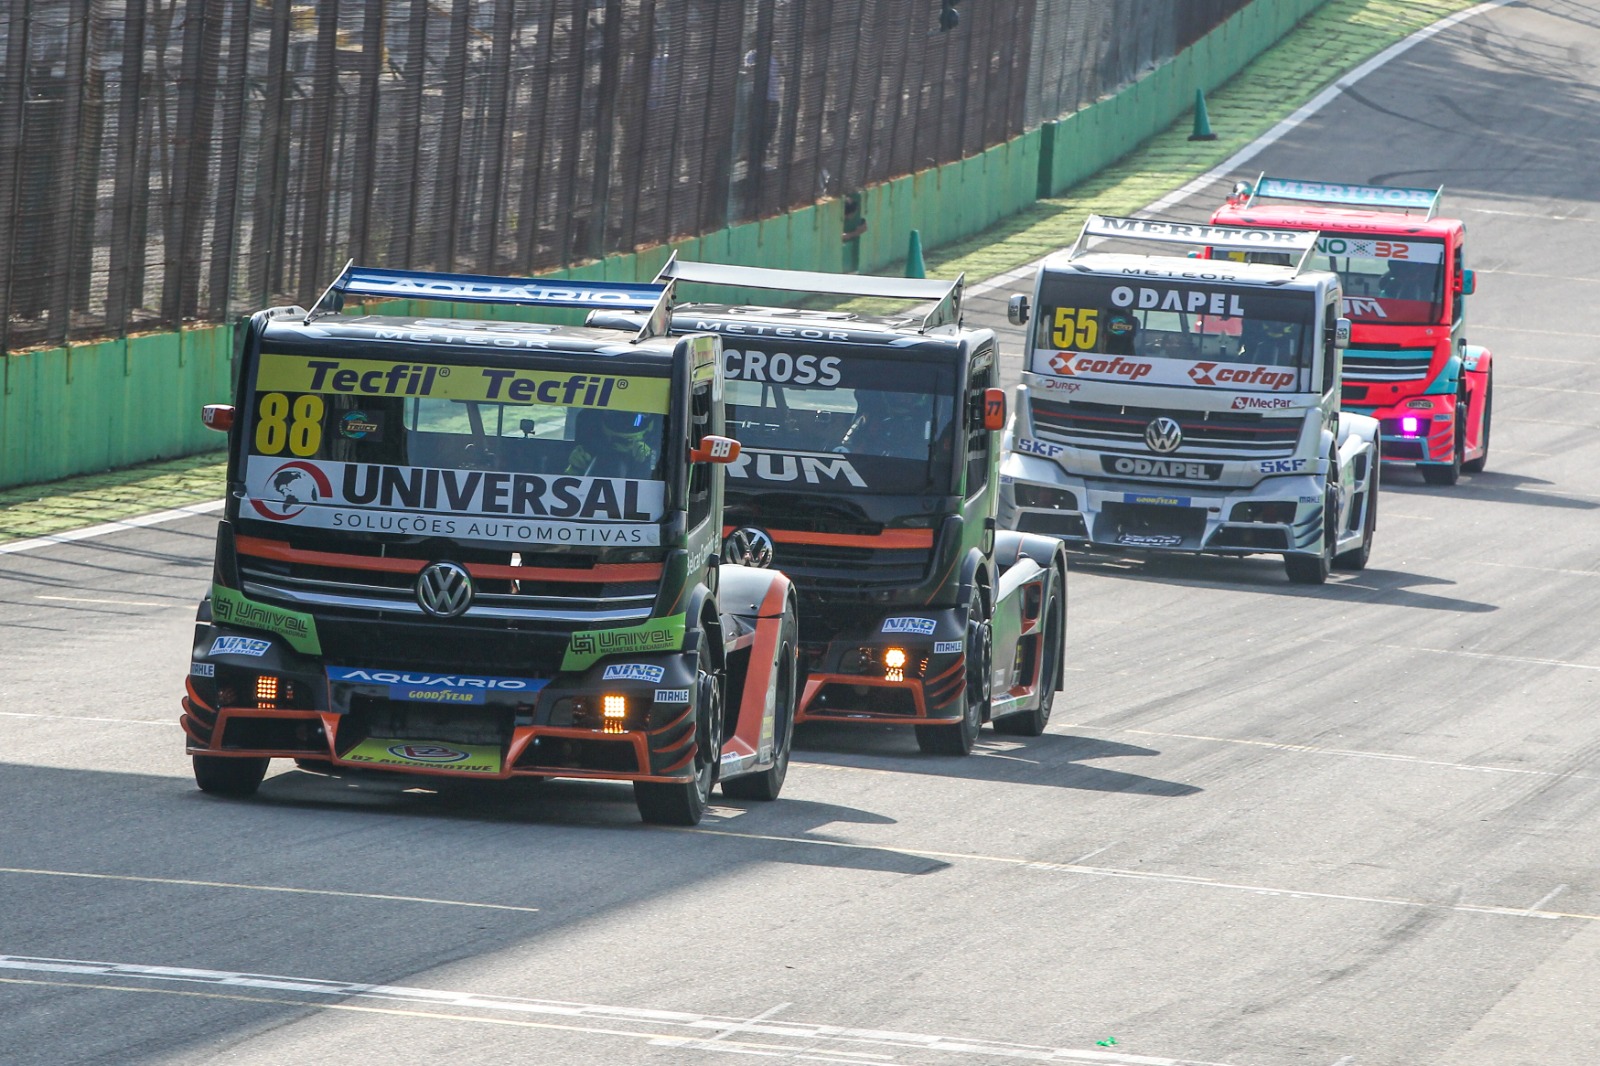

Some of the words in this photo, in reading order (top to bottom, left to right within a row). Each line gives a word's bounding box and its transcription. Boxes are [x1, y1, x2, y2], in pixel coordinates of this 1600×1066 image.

[1267, 180, 1429, 203] MERITOR
[1102, 217, 1297, 243] MERITOR
[1281, 219, 1377, 230] METEOR
[1374, 241, 1409, 259] 32
[1122, 267, 1236, 282] METEOR
[1111, 286, 1244, 316] ODAPEL
[698, 322, 849, 341] METEOR
[1053, 307, 1098, 350] 55
[374, 330, 550, 348] METEOR
[1074, 358, 1152, 380] cofap
[1215, 369, 1295, 390] cofap
[986, 401, 1002, 417] 77
[1248, 397, 1292, 409] MecPar
[255, 392, 324, 457] 88
[710, 440, 732, 458] 88
[1019, 438, 1064, 458] SKF
[1115, 458, 1210, 480] ODAPEL
[1260, 459, 1308, 474] SKF
[342, 462, 651, 521] UNIVERSAL
[332, 511, 456, 536] SOLUÇÕES
[467, 522, 642, 543] AUTOMOTIVAS
[884, 618, 934, 630] NINO
[213, 637, 268, 652] NINO
[935, 642, 962, 652] MAHLE
[342, 670, 527, 689] AQUÁRIO
[606, 665, 663, 678] NINO
[408, 689, 473, 702] GOODYEAR
[656, 690, 688, 701] MAHLE
